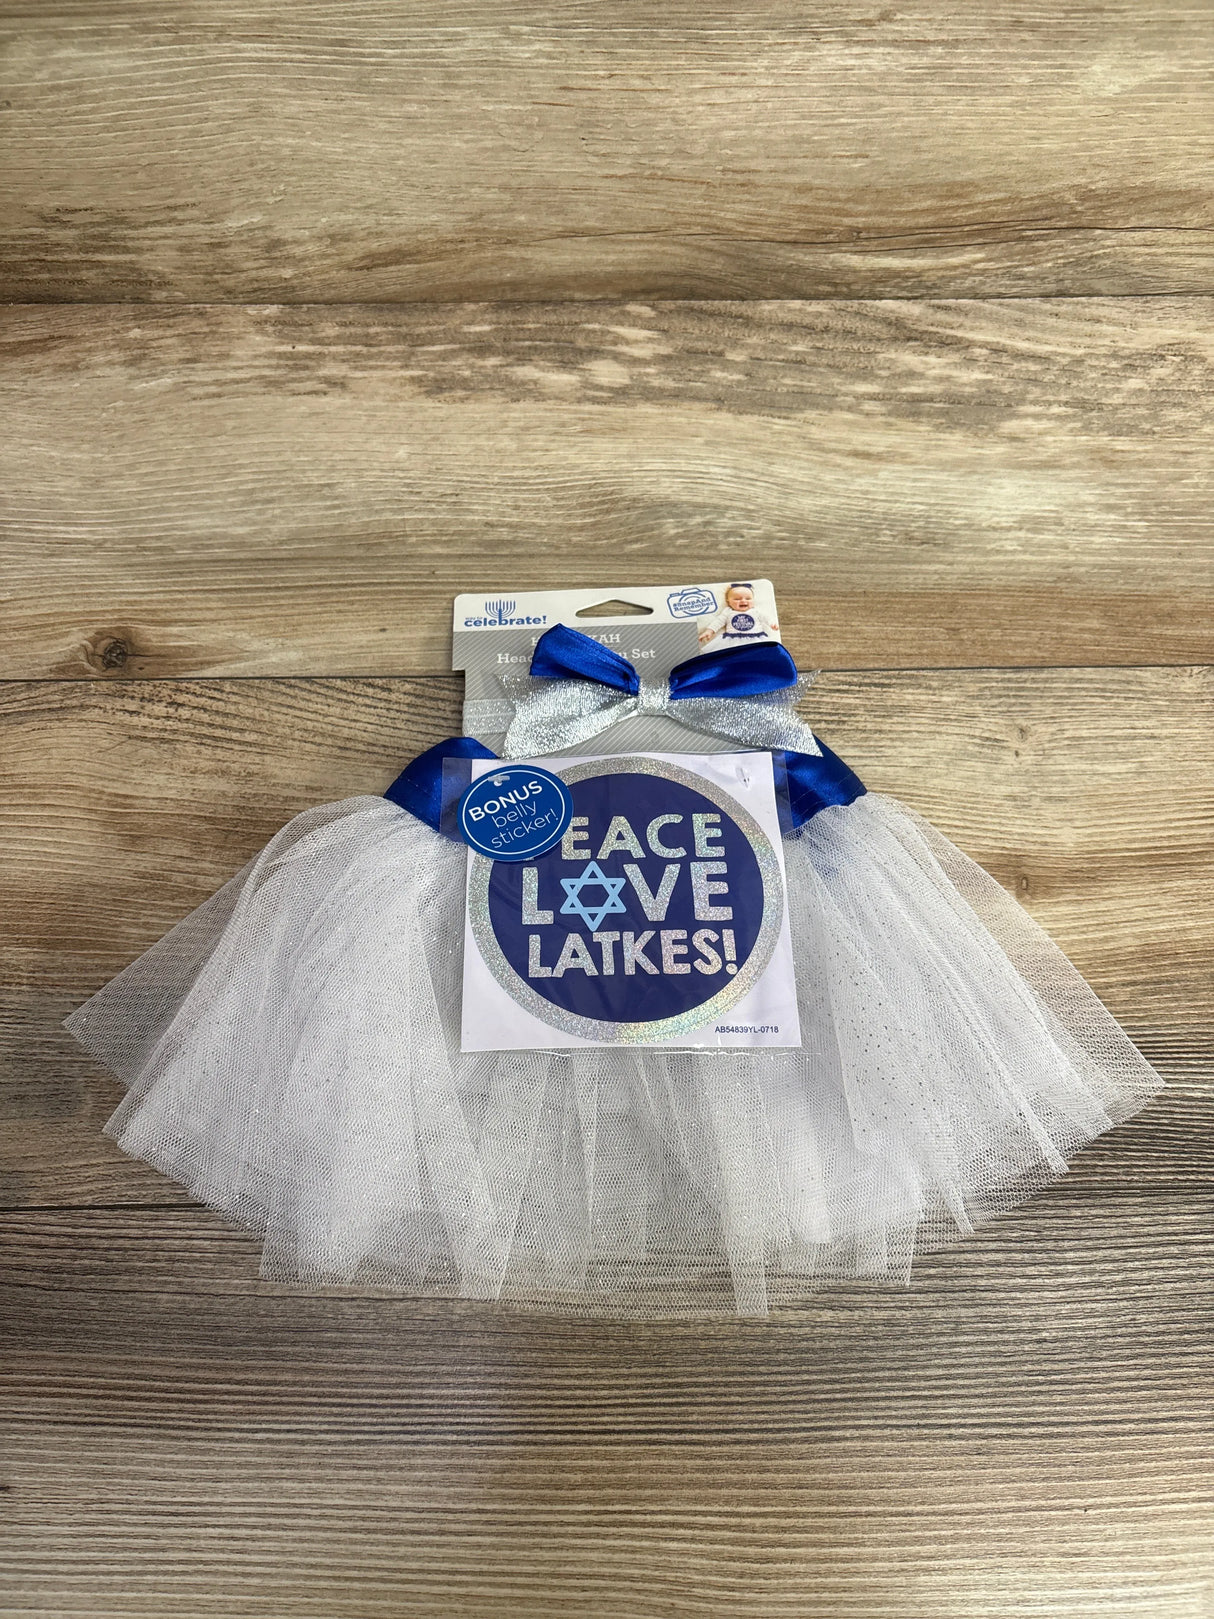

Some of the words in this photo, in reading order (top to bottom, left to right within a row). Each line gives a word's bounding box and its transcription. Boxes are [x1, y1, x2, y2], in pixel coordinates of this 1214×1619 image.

[464, 614, 547, 627] celebrate!
[631, 648, 656, 659] Set
[468, 780, 543, 822] BONUS
[491, 801, 537, 828] belly
[491, 808, 559, 848] sticker!
[530, 813, 726, 861] EACE
[528, 929, 738, 979] LATKES!
[715, 1025, 779, 1034] AB54839YL-0718
